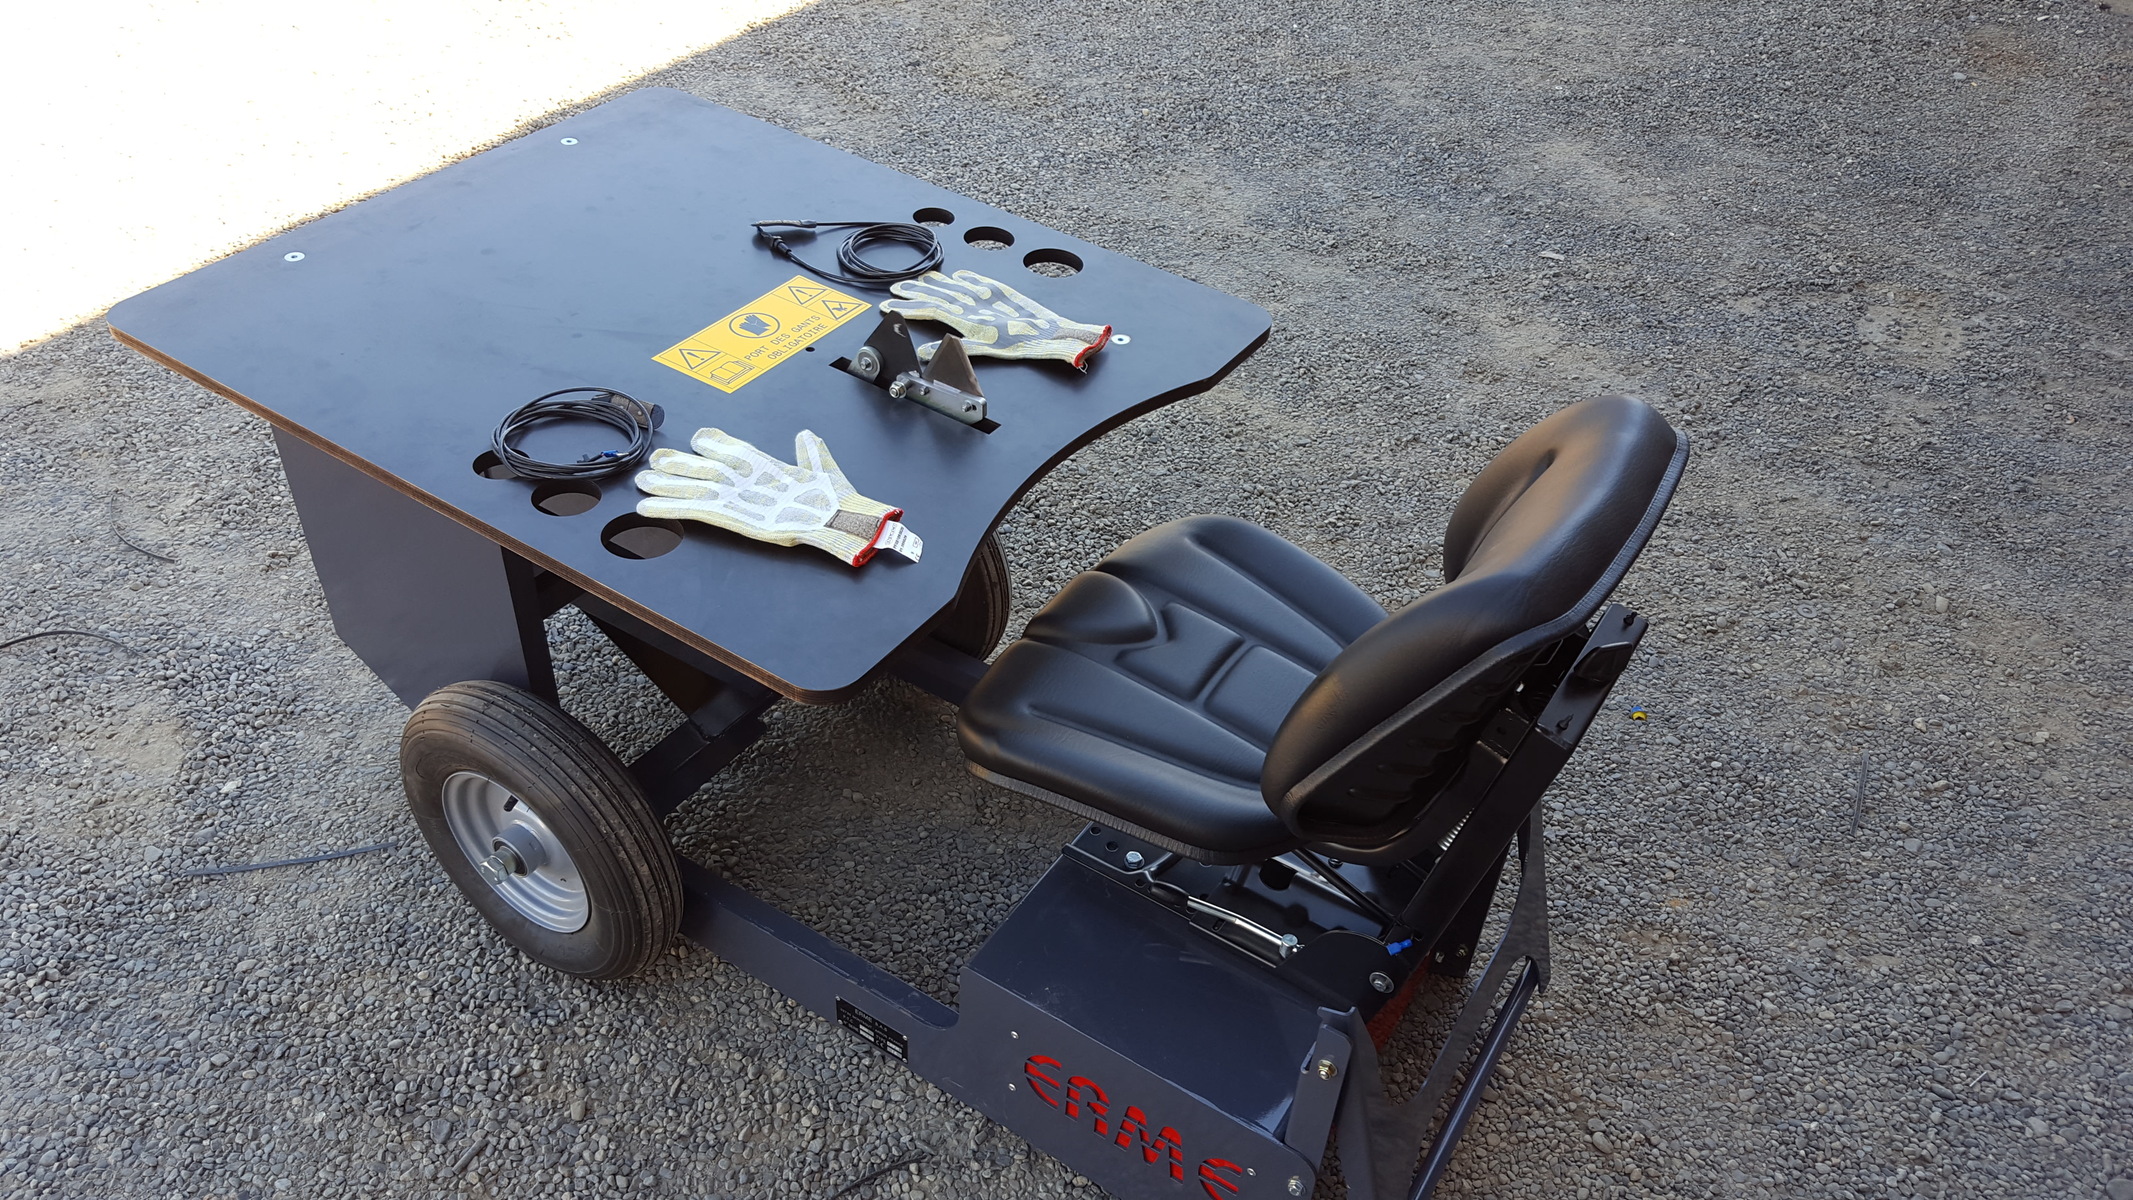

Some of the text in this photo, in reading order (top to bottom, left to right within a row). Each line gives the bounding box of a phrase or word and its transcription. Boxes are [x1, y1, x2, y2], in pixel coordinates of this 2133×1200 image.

[744, 315, 821, 360] PORT DES GANTS
[767, 322, 829, 360] OBLIGATOIRE
[1024, 1055, 1243, 1200] ERME
